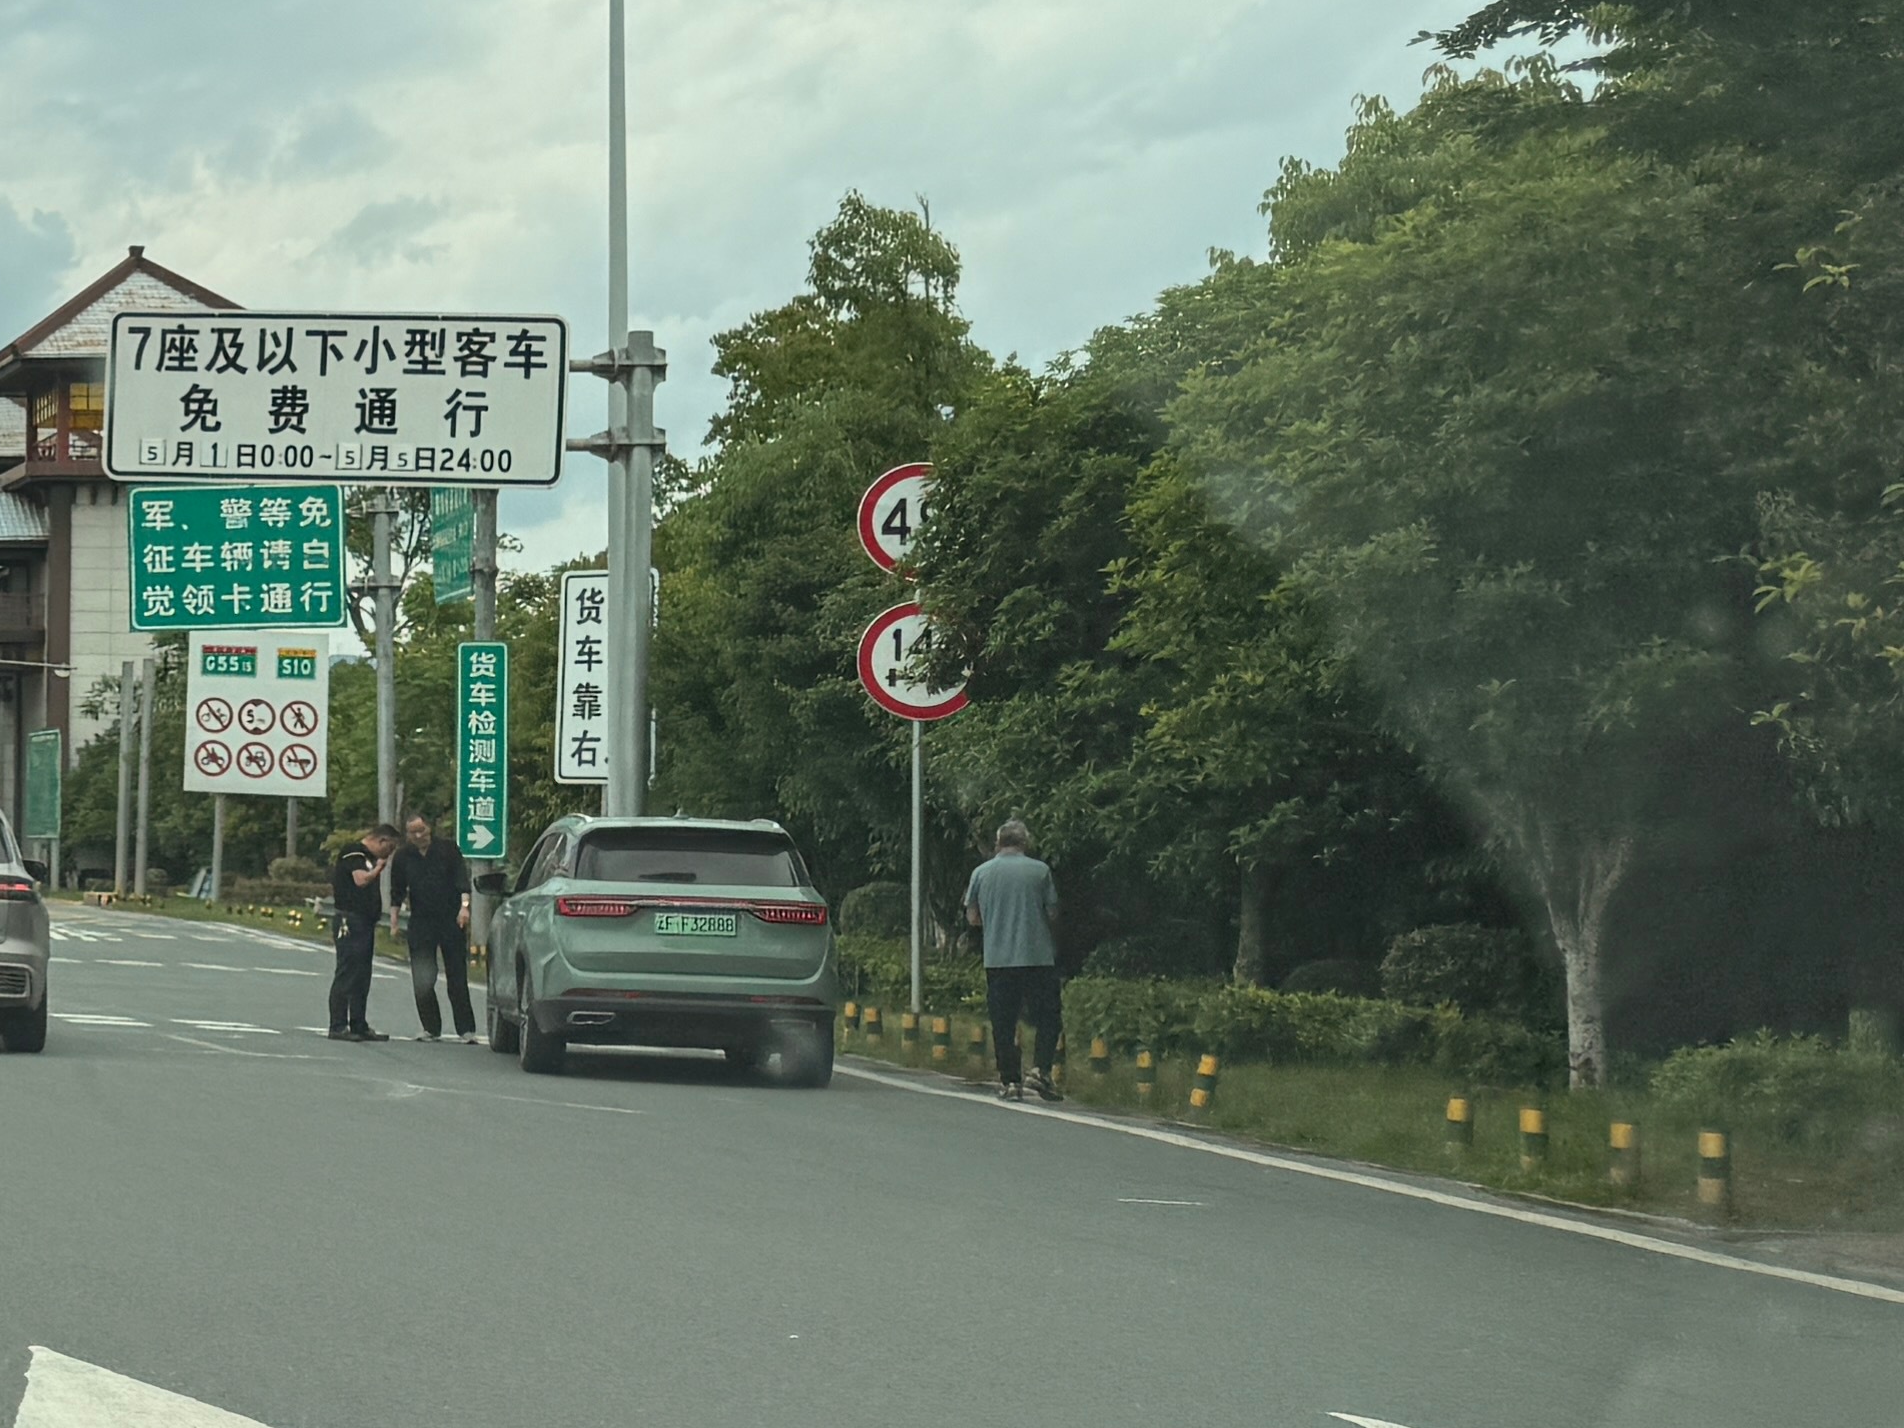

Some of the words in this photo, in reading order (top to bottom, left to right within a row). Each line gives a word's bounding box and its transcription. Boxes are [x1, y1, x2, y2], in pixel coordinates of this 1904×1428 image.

[127, 324, 549, 380] 7座及以下小型客车
[142, 581, 333, 617] 觉领卡通行
[282, 659, 312, 675] S10
[468, 651, 497, 822] 货车检测车道
